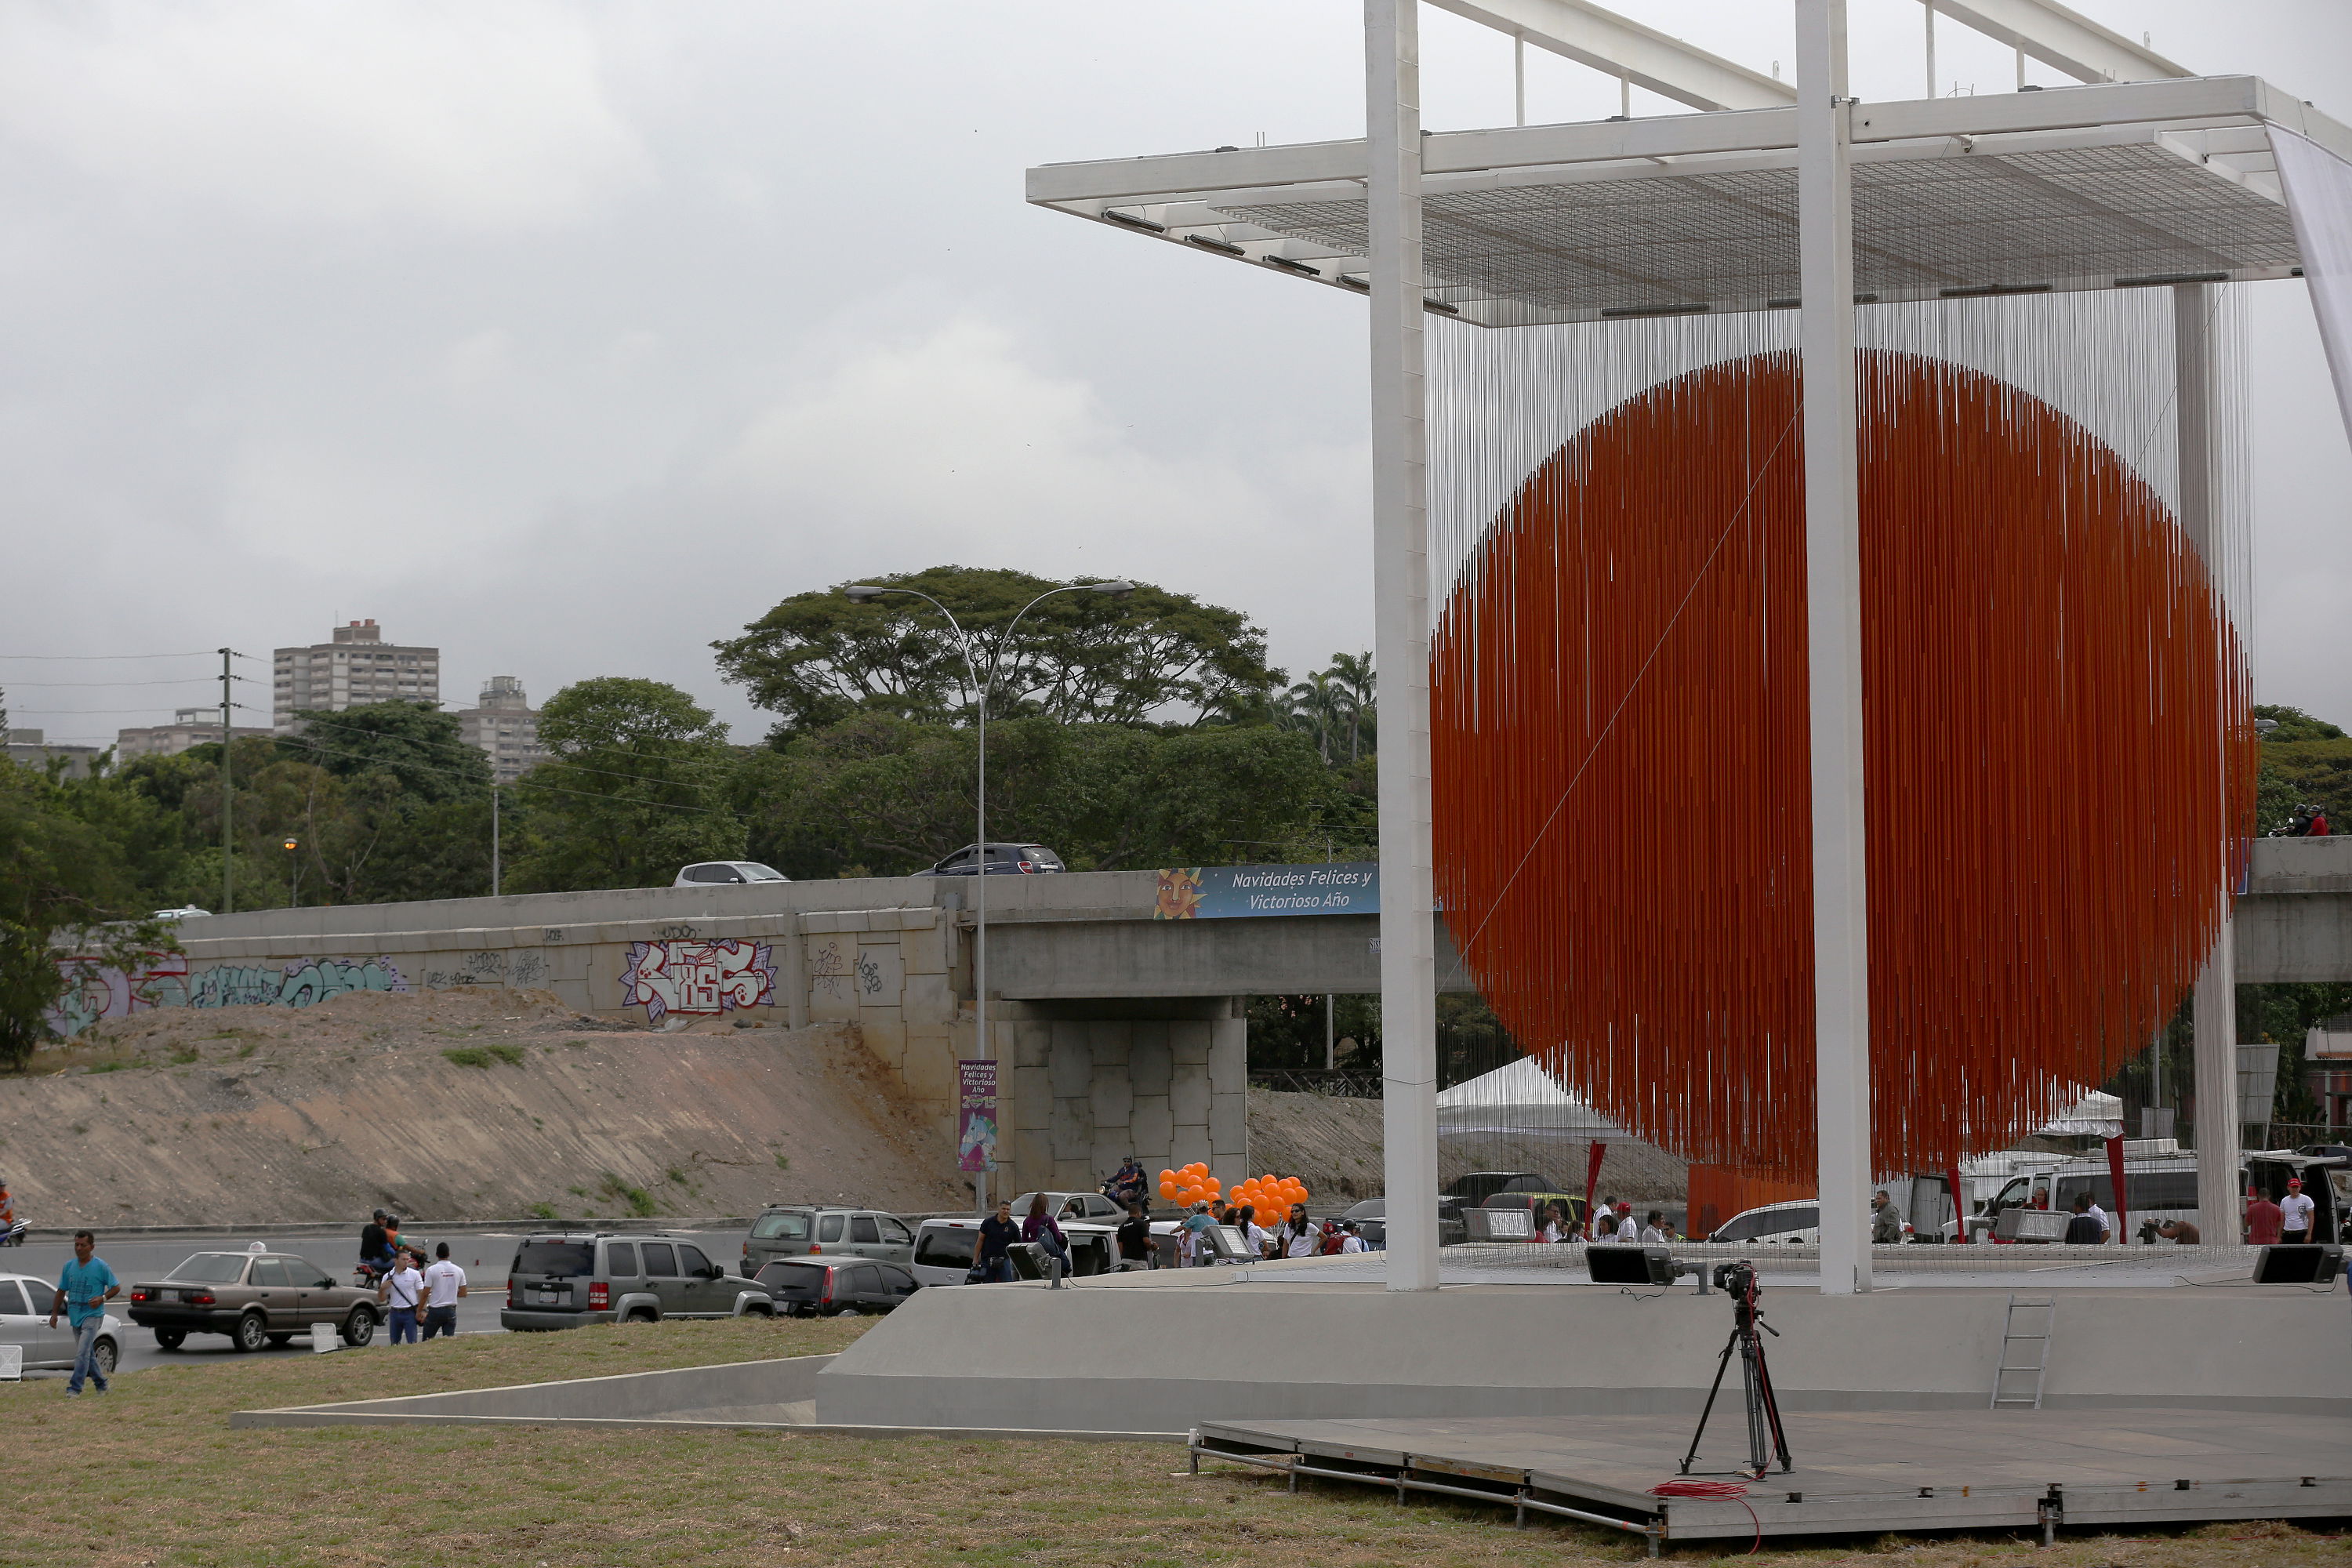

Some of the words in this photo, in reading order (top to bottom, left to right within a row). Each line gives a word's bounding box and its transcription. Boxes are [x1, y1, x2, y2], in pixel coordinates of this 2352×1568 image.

[1232, 871, 1305, 887] Navidades
[1308, 869, 1359, 885] Felices
[1361, 873, 1372, 887] y
[1250, 892, 1319, 909] Victorioso
[1322, 891, 1350, 907] Año
